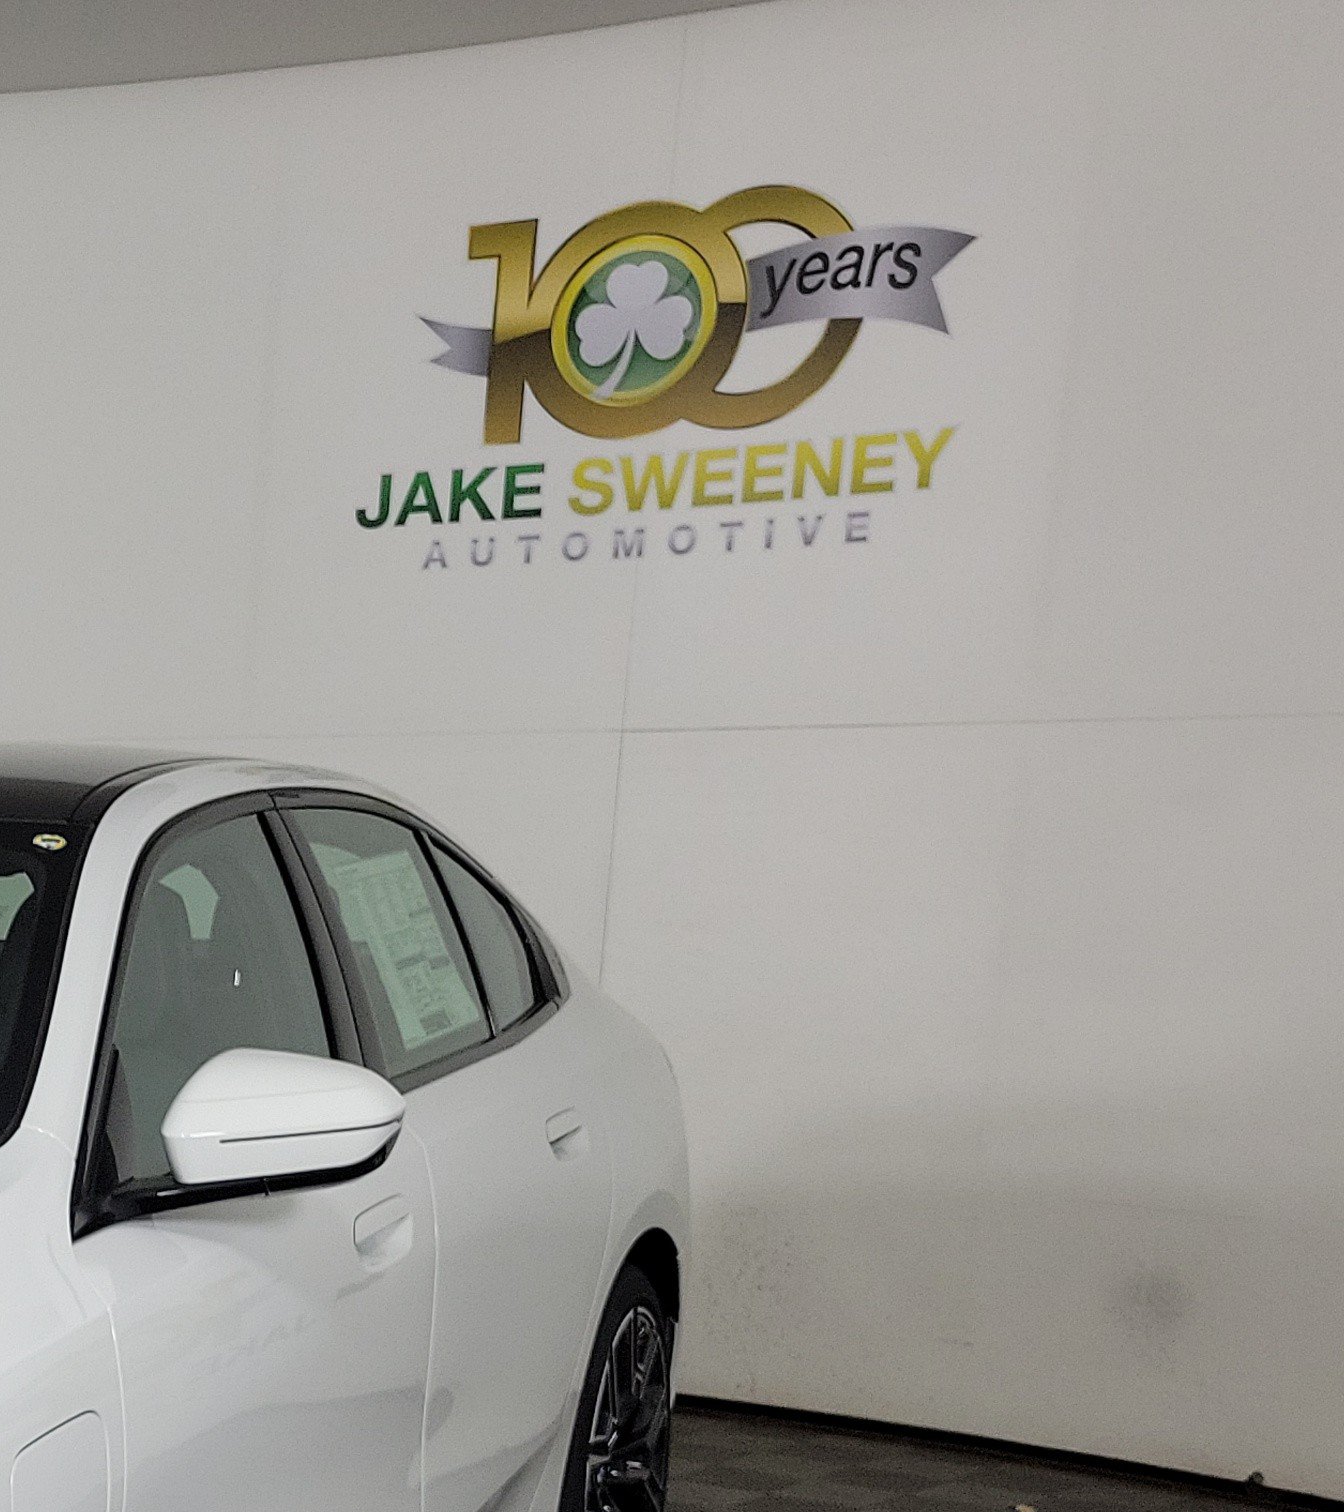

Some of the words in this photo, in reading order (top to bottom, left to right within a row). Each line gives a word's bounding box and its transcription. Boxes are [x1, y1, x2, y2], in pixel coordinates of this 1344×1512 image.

[468, 184, 863, 444] 100
[760, 238, 923, 317] years
[355, 463, 546, 529] JAKE
[568, 427, 955, 517] SWEENEY
[423, 512, 872, 570] AUTOMOTIVE
